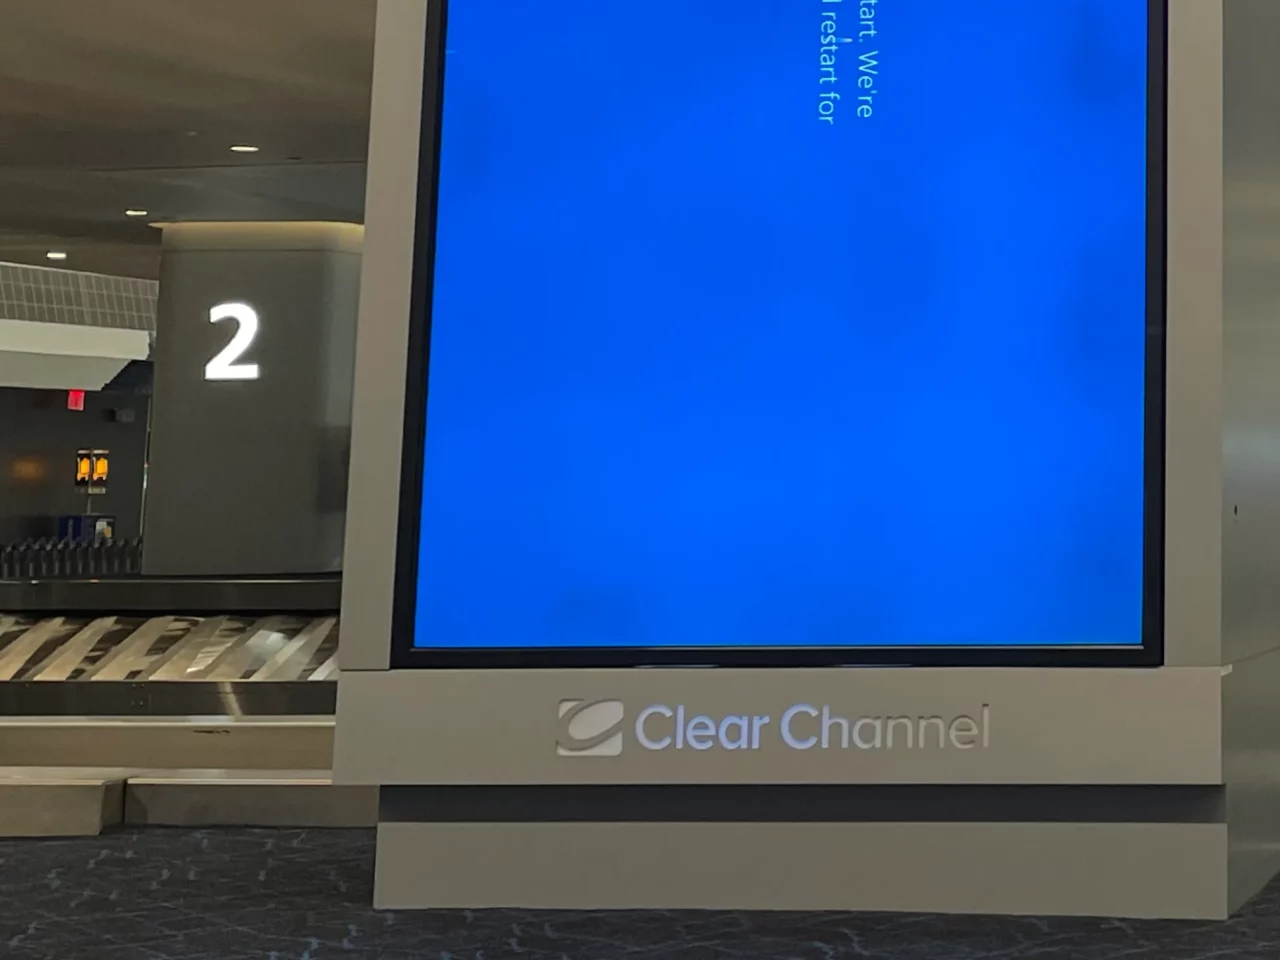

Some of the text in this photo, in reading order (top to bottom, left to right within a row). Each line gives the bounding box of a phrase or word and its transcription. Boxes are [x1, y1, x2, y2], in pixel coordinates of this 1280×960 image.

[819, 12, 838, 84] restart
[819, 92, 840, 124] for
[857, 51, 878, 117] We're
[203, 302, 260, 381] 2
[635, 702, 990, 750] Clear Channel
